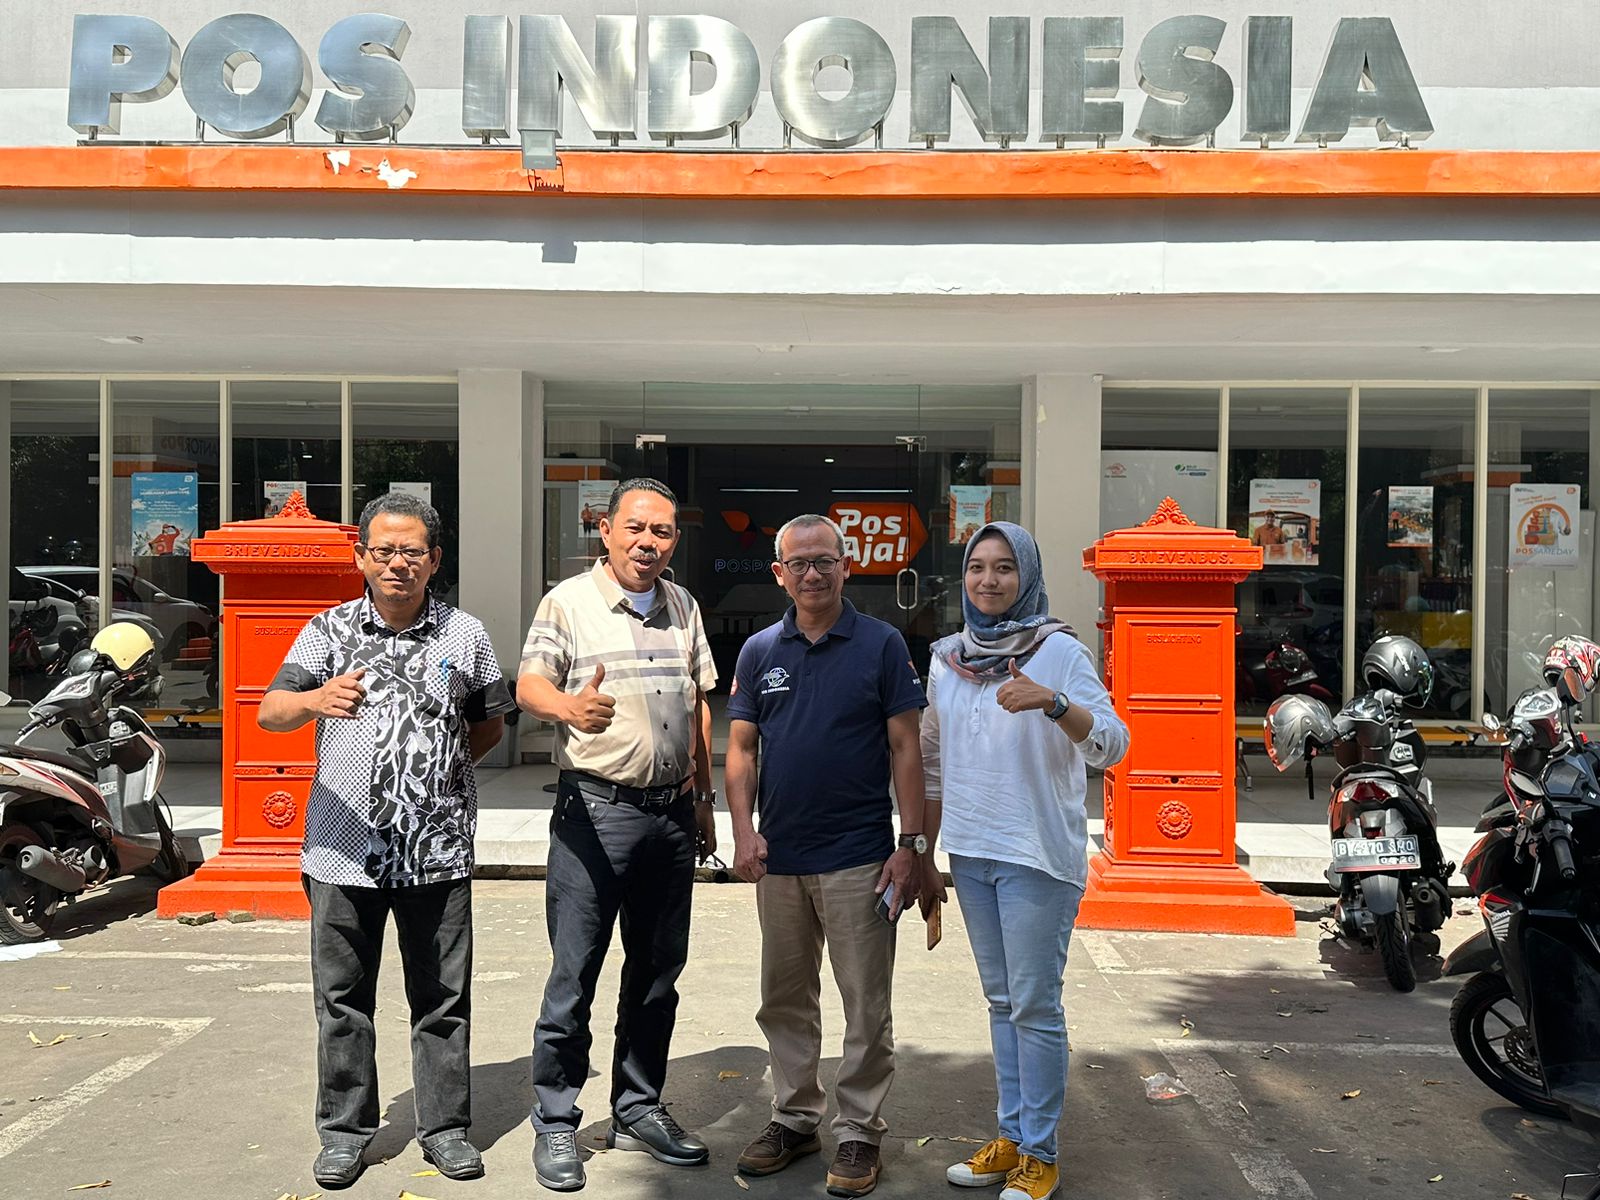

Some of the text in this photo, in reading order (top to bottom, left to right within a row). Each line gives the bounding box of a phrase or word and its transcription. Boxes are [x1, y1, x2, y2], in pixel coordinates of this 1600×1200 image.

[67, 12, 1435, 147] POS INDONESIA
[836, 509, 902, 535] Pos
[223, 544, 328, 558] BRIEVENBUS.
[843, 536, 909, 568] Aja!
[1128, 551, 1234, 565] BRIEVENBUS.
[714, 558, 772, 573] POSPA
